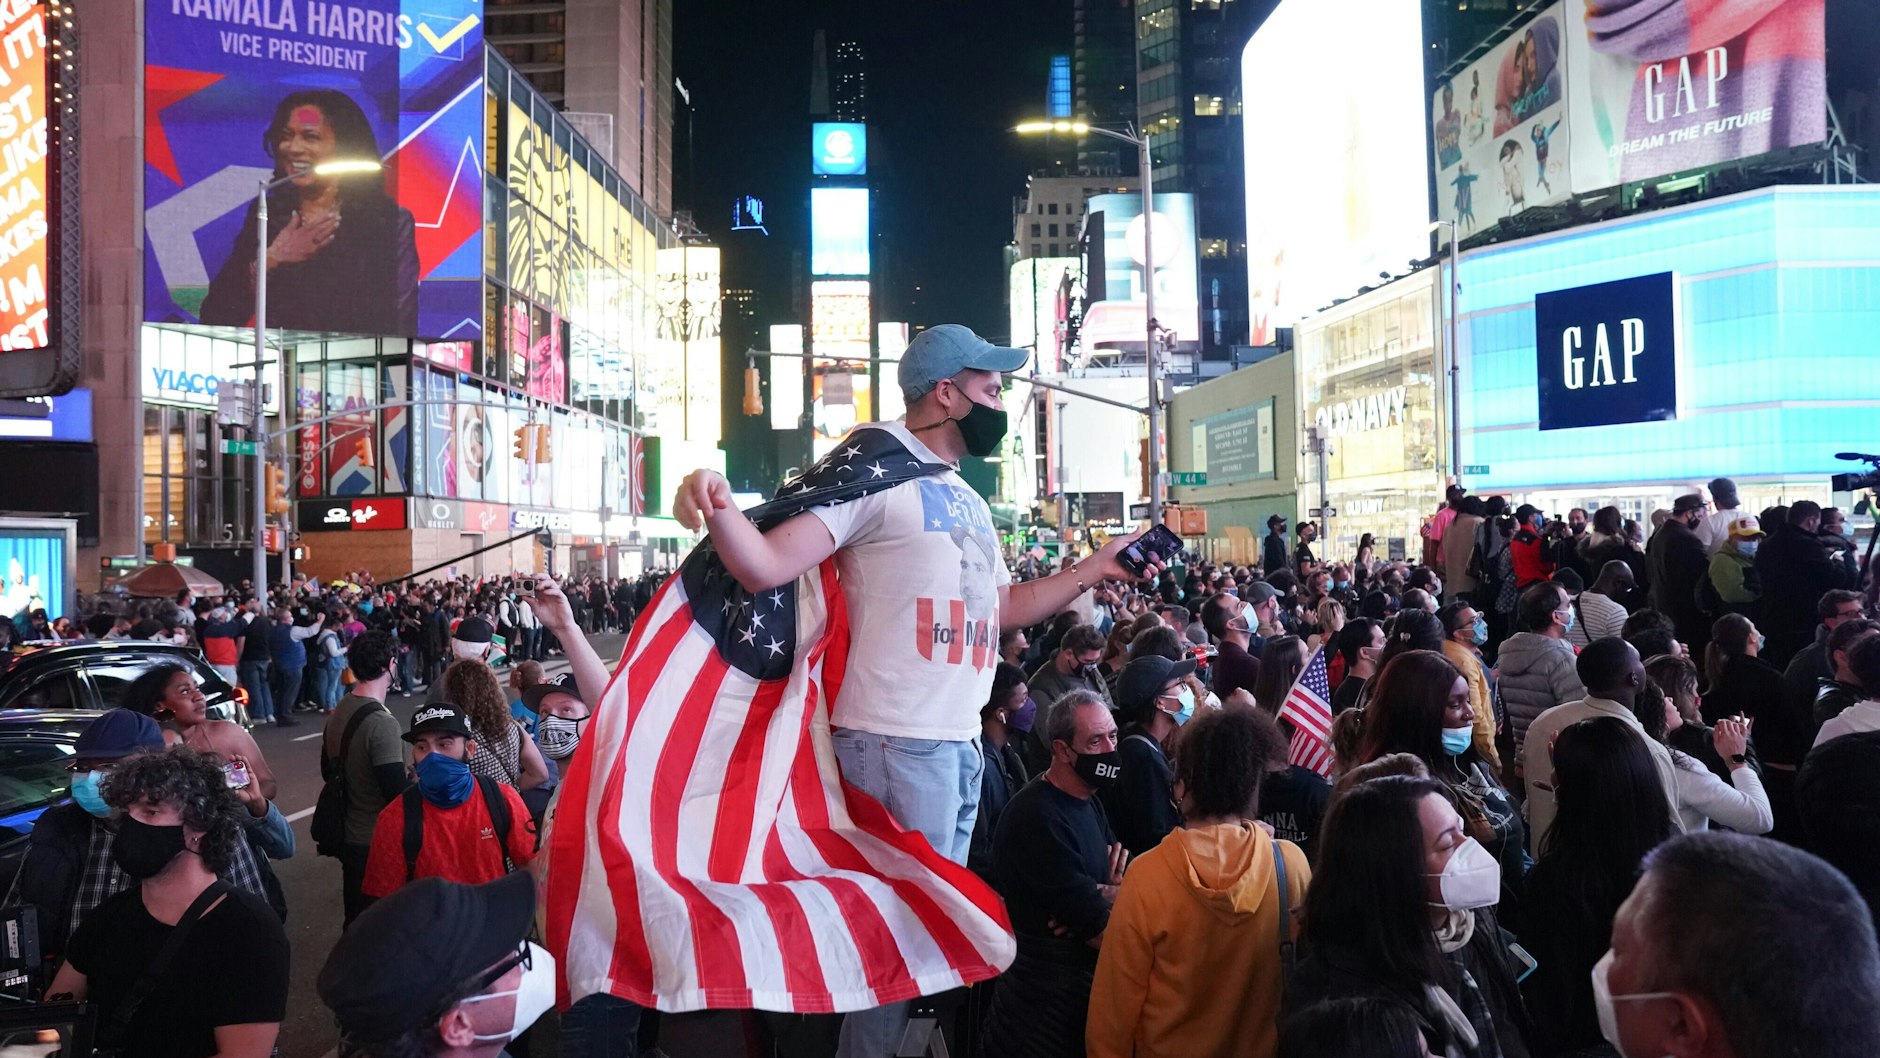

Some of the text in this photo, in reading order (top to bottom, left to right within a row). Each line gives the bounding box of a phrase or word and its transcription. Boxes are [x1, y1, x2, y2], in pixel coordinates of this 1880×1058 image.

[306, 1, 414, 49] HARRIS
[219, 30, 368, 72] VICE PRESIDENT
[1644, 46, 1728, 123] GAP
[1608, 106, 1773, 158] DREAM THE FUTURE
[1562, 317, 1645, 390] GAP
[152, 367, 227, 396] VIACO
[1315, 385, 1408, 438] OLD NAVY
[303, 441, 315, 474] CBS
[1172, 473, 1182, 484] W
[1185, 473, 1196, 484] 44
[1463, 466, 1469, 474] W
[1472, 466, 1481, 474] 44
[932, 622, 957, 644] for
